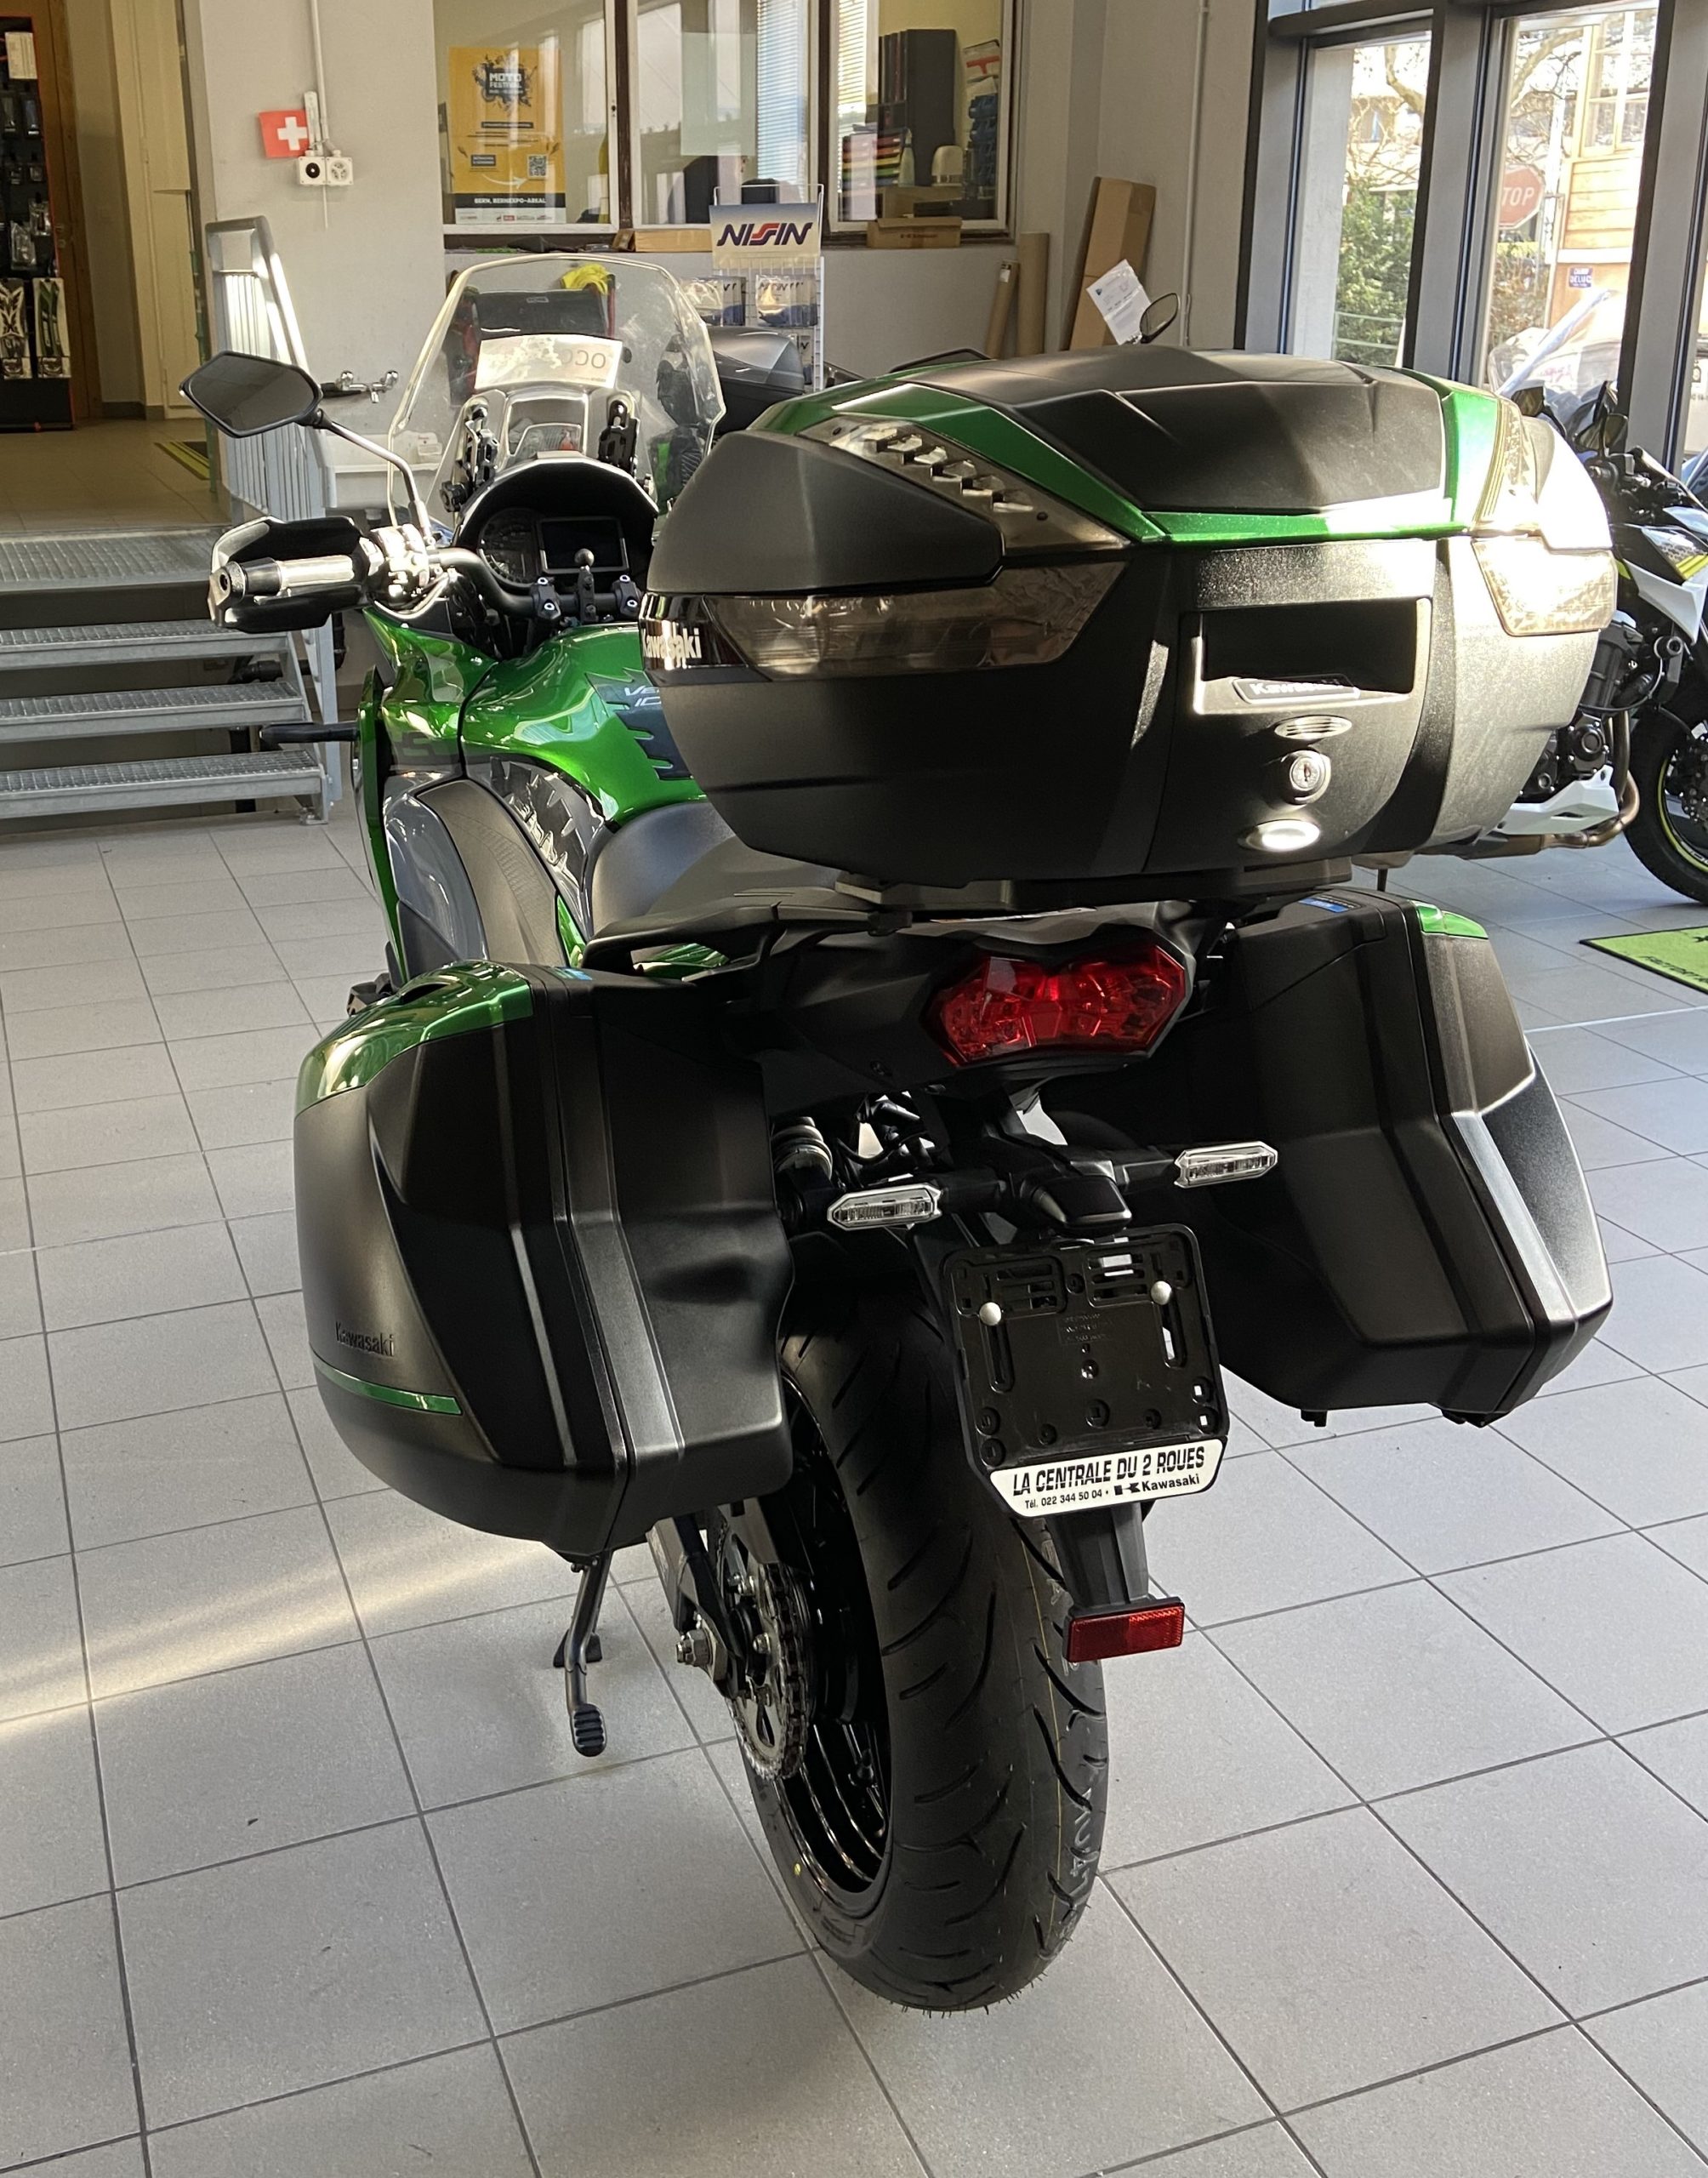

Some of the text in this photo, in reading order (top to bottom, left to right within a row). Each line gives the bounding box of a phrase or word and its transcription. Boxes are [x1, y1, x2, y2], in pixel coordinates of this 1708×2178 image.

[489, 73, 522, 82] MOTO
[1502, 186, 1535, 207] TOP
[716, 222, 813, 247] NISSIN
[641, 628, 702, 659] Kawasaki
[335, 1321, 395, 1356] Kawasaki
[1013, 1445, 1204, 1497] LA CENTRALE DU 2 ROUES
[1041, 1496, 1057, 1506] 022
[1060, 1493, 1076, 1503] 344
[1078, 1491, 1090, 1501] 50
[1091, 1489, 1102, 1499] 04
[1142, 1473, 1200, 1492] Kawasaki
